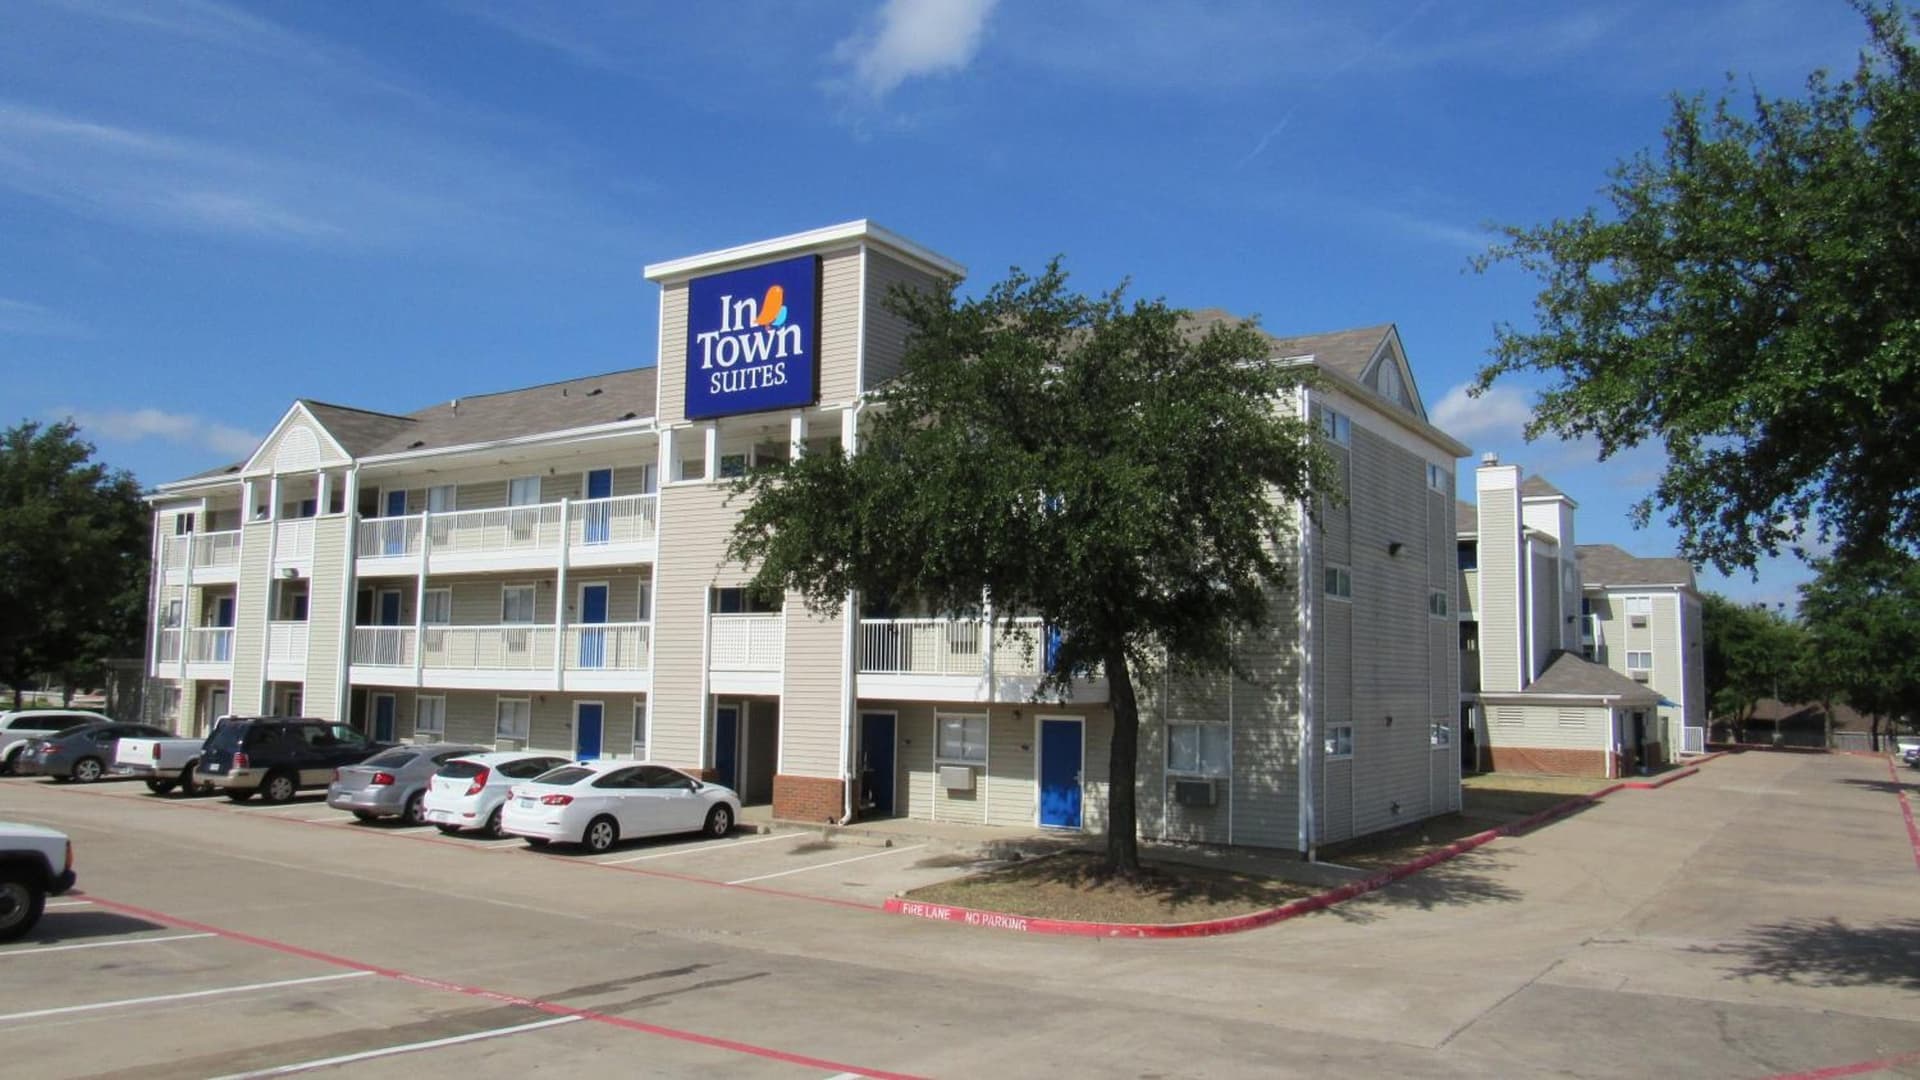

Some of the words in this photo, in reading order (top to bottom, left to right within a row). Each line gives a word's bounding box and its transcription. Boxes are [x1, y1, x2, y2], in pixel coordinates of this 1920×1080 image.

[721, 295, 759, 332] In
[903, 903, 923, 916] FIRE
[926, 908, 951, 920] LANE
[965, 912, 980, 925] NO
[982, 915, 1027, 931] PARKING
